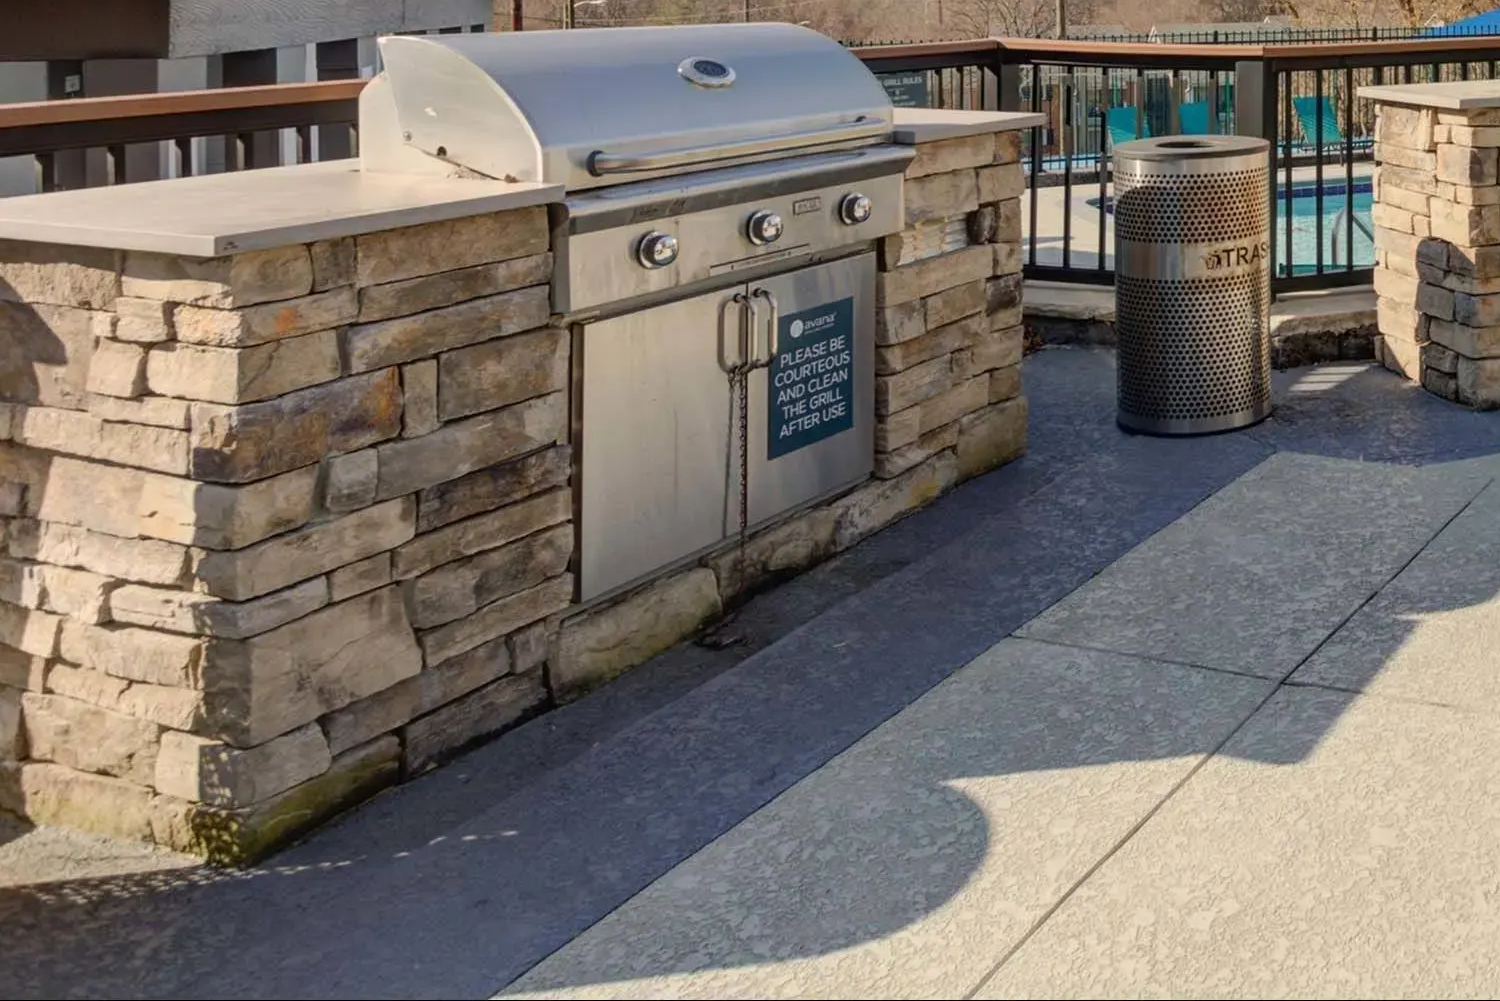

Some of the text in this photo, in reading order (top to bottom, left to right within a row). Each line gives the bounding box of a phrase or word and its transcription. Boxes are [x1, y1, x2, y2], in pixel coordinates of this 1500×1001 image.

[1222, 242, 1268, 267] TRAS
[805, 314, 835, 329] avana
[774, 350, 850, 387] COURTEOUS
[780, 334, 845, 369] PLEASE BE
[777, 368, 848, 405] AND CLEAN
[782, 387, 843, 420] THE GRILL
[779, 402, 847, 439] AFTER USE
